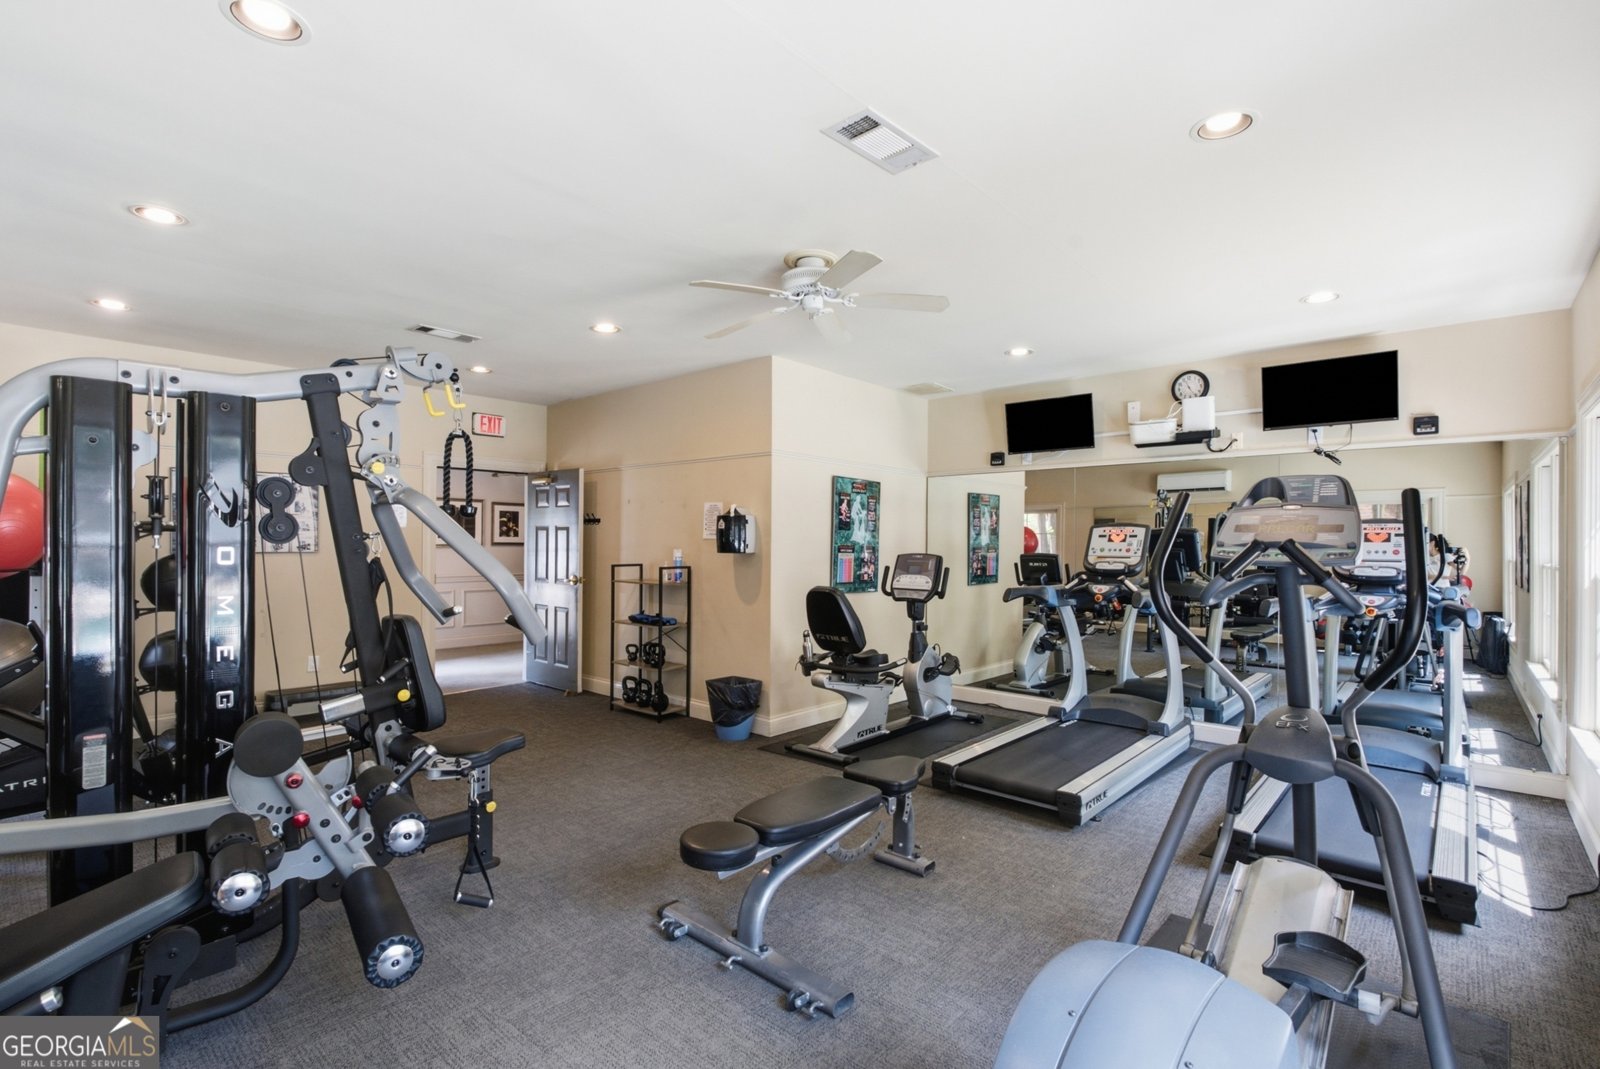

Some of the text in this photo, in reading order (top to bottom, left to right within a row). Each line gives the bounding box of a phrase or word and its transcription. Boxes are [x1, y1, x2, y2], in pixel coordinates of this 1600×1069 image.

[480, 415, 502, 434] EXIT
[215, 546, 235, 758] OMEGA
[864, 724, 883, 736] TRUE
[1275, 721, 1309, 732] EFX
